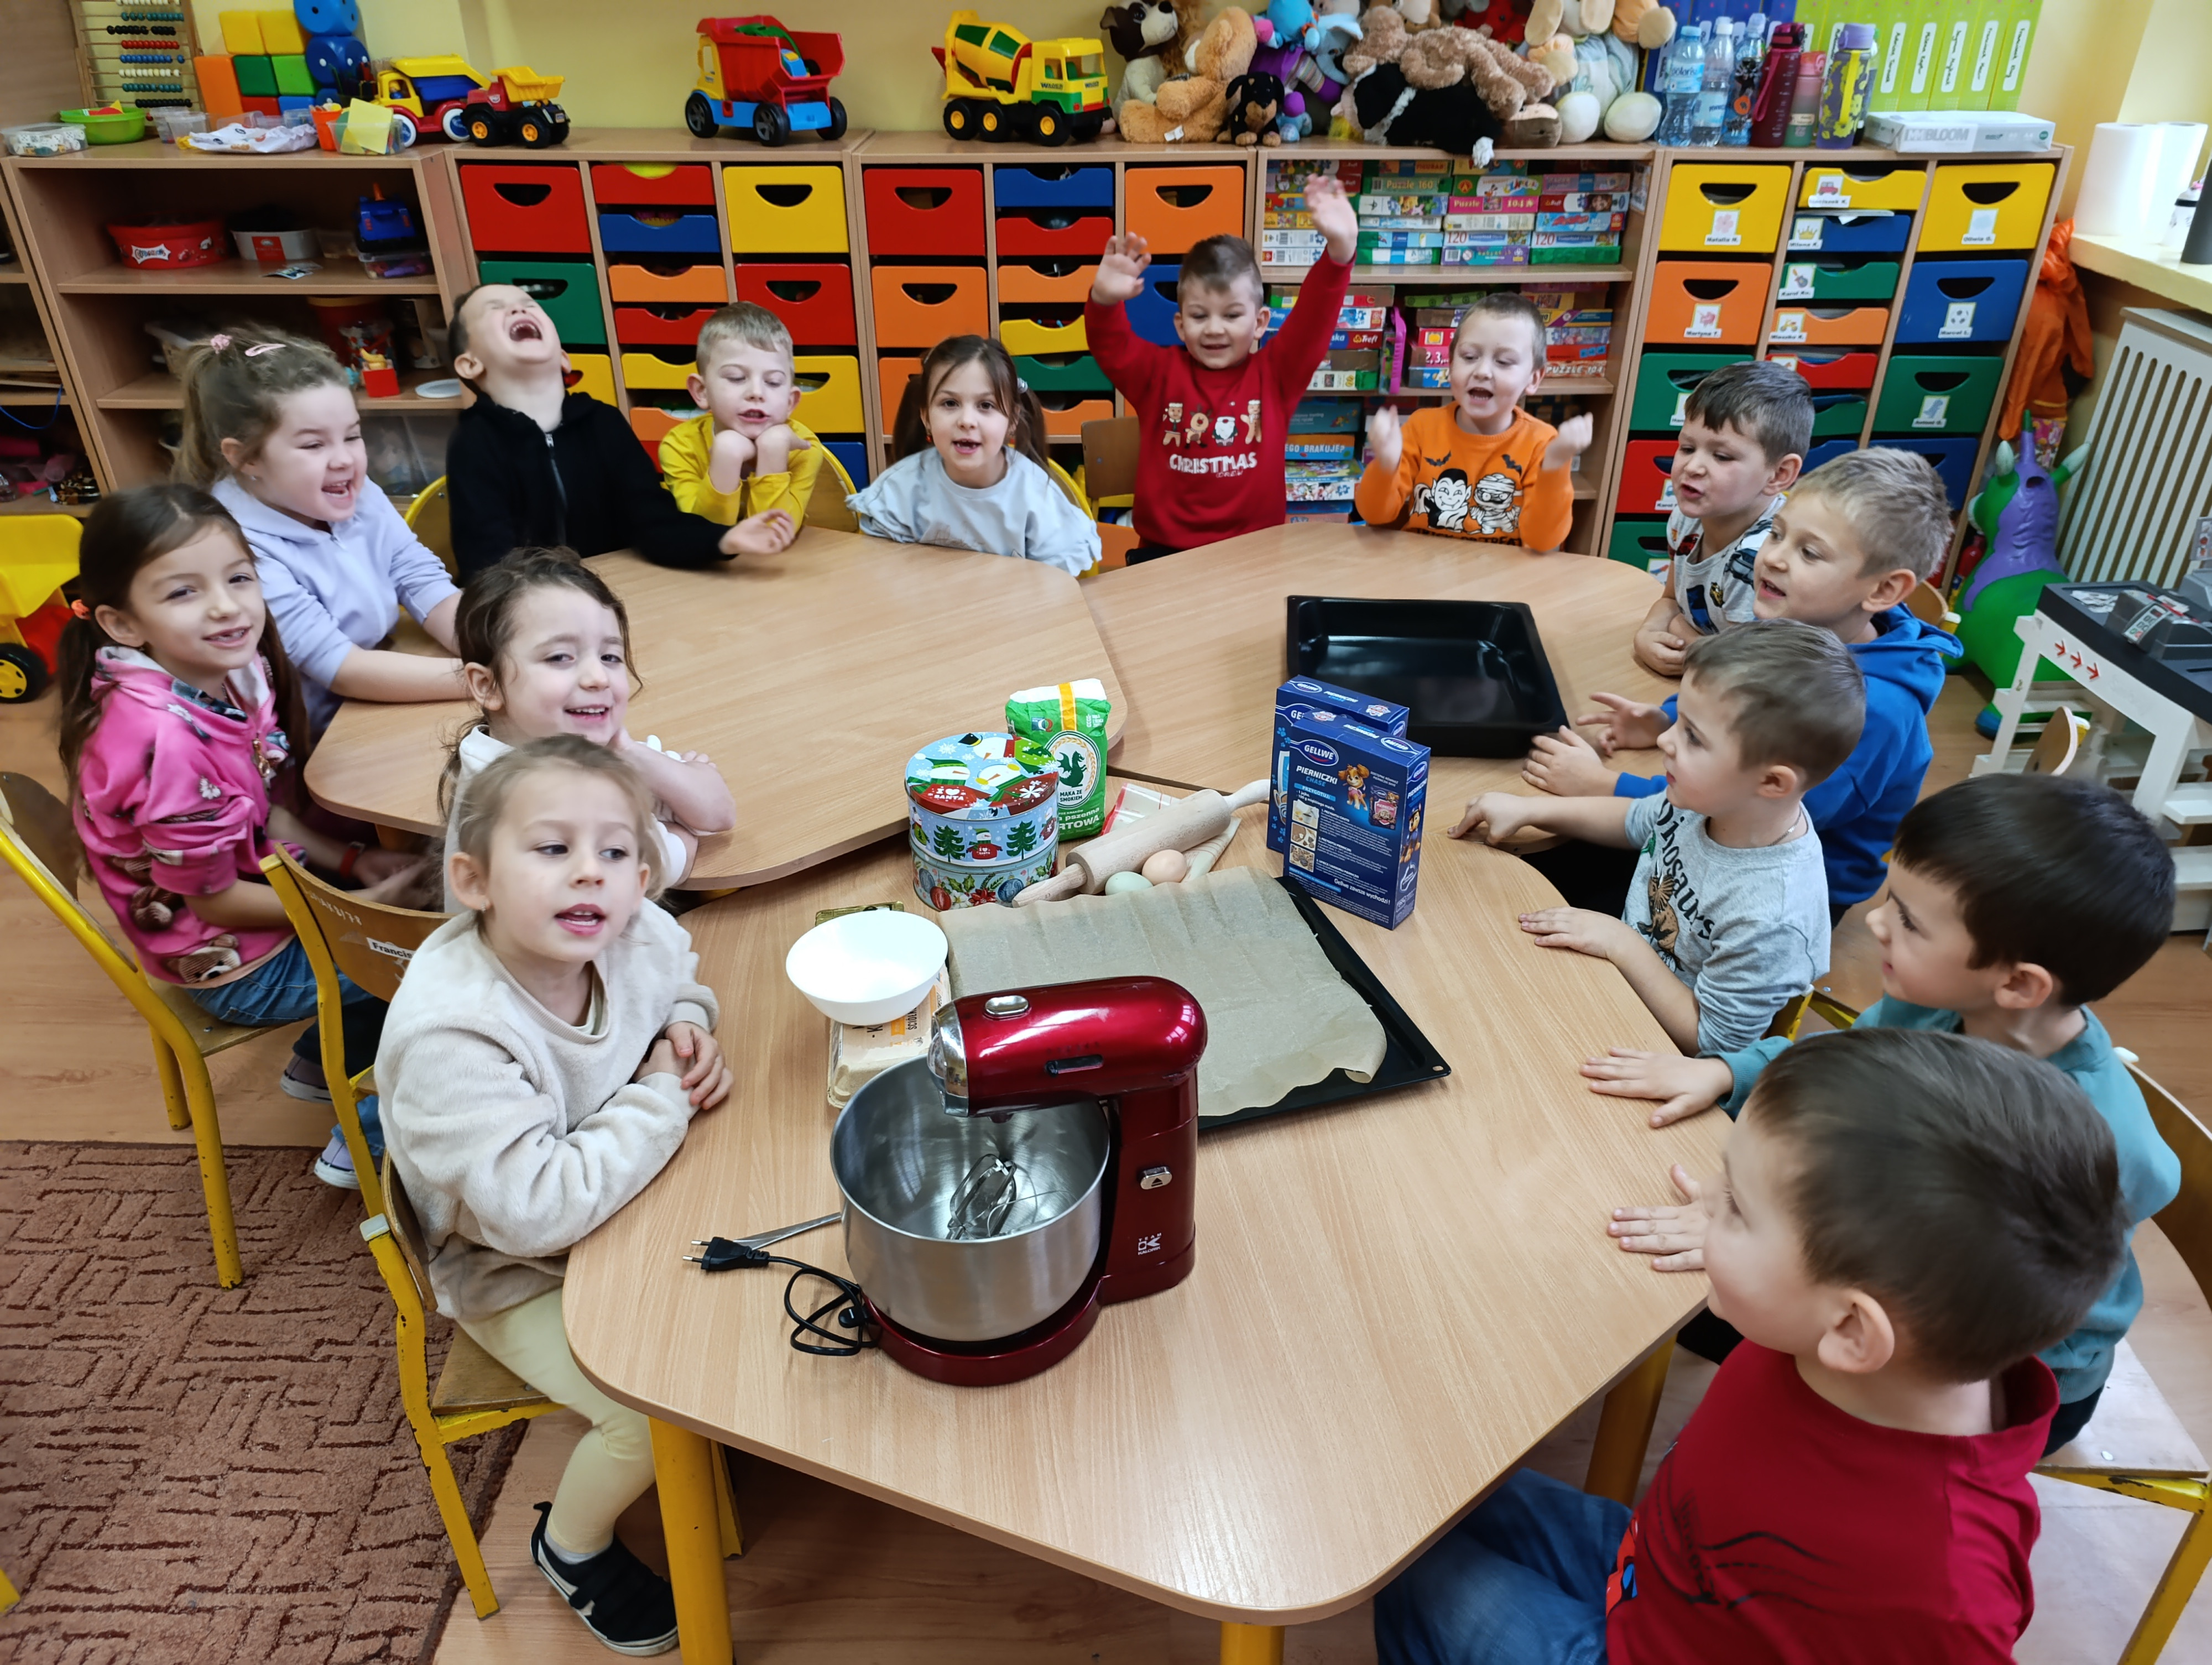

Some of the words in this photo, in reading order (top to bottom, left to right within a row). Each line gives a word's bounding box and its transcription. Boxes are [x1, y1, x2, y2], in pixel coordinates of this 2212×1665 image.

[1386, 180, 1414, 189] Puzzle
[1419, 180, 1433, 189] 160
[1448, 231, 1467, 243] 120
[1535, 232, 1555, 245] 120
[1546, 364, 1583, 374] PUZZLE
[1587, 366, 1603, 374] 104
[1285, 444, 1300, 453] EGO
[1304, 444, 1345, 453] BRAKUJE?
[1170, 452, 1258, 474] CHRISTMAS
[1304, 744, 1334, 760] GELLWE
[1296, 765, 1338, 785] PIERNICZKI
[1306, 776, 1327, 787] CHASE
[1065, 807, 1099, 821] pszenna
[1059, 815, 1099, 830] RTOWA
[1334, 878, 1349, 889] Gellwe
[1349, 886, 1365, 895] zawsze
[1366, 892, 1388, 905] wychodzi
[1139, 1233, 1161, 1242] TEAM
[1138, 1246, 1161, 1255] KALORIK
